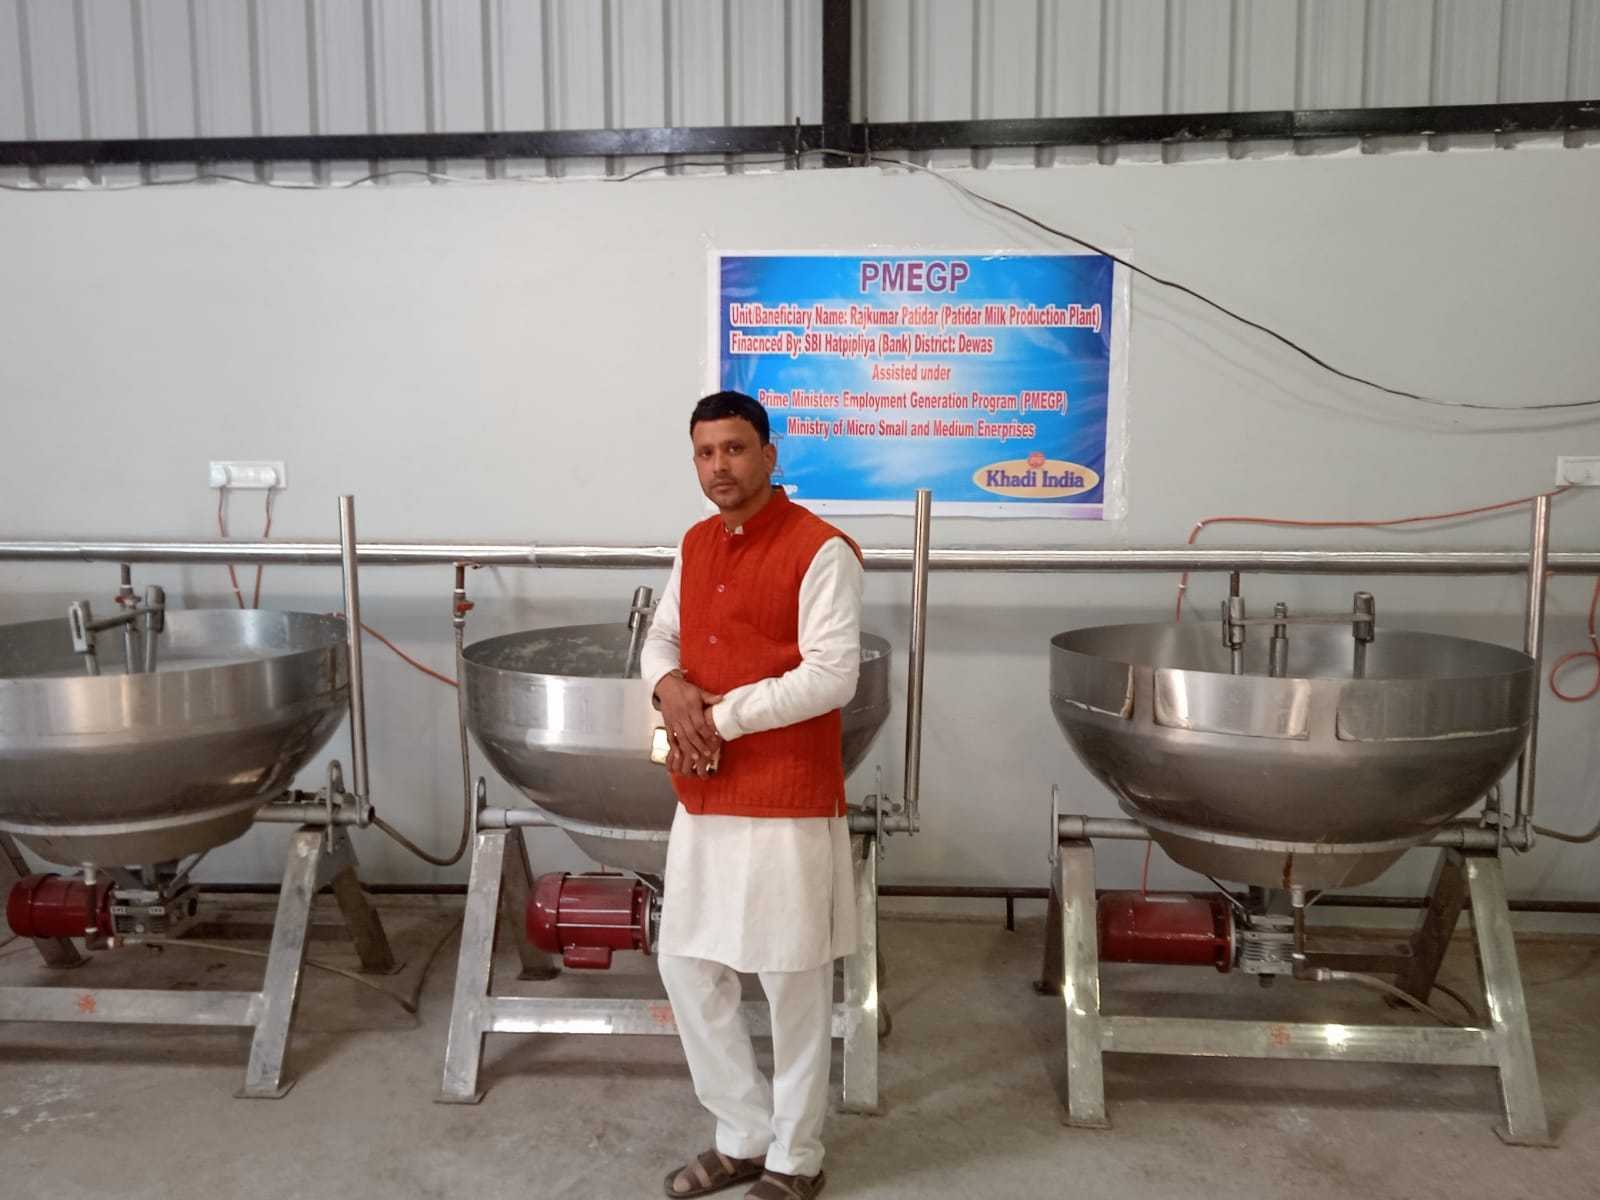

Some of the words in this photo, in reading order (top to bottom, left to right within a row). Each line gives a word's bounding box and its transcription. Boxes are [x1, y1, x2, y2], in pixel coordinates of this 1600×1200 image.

[861, 262, 969, 293] PMEGP
[732, 305, 752, 325] Unit
[754, 306, 812, 330] Baneficiary
[815, 306, 848, 325] Name:
[850, 306, 899, 329] Rajkumar
[901, 306, 938, 325] Patidar
[941, 306, 981, 329] (Patidar
[984, 306, 1007, 325] Milk
[1009, 306, 1066, 325] Production
[1069, 306, 1101, 330] Plant)
[731, 333, 783, 352] Finacnced
[786, 333, 801, 357] By:
[804, 333, 822, 352] SBI
[825, 333, 875, 357] Hatpipliya
[878, 333, 912, 356] (Bank)
[914, 333, 956, 353] District:
[959, 334, 993, 353] Dewas
[872, 363, 918, 381] Assisted
[920, 365, 951, 381] under
[758, 389, 789, 407] Prime
[792, 390, 840, 408] Ministers
[843, 391, 907, 412] Employment
[910, 391, 969, 409] Generation
[971, 391, 1018, 412] Program
[1020, 391, 1068, 415] (PMEGP)
[787, 417, 831, 439] Ministry
[833, 418, 844, 435] of
[846, 418, 876, 436] Micro
[878, 418, 909, 437] Small
[911, 420, 930, 437] and
[933, 420, 974, 437] Medium
[977, 420, 1035, 441] Enerprises
[986, 469, 1037, 488] Khadi
[1042, 470, 1085, 488] India
